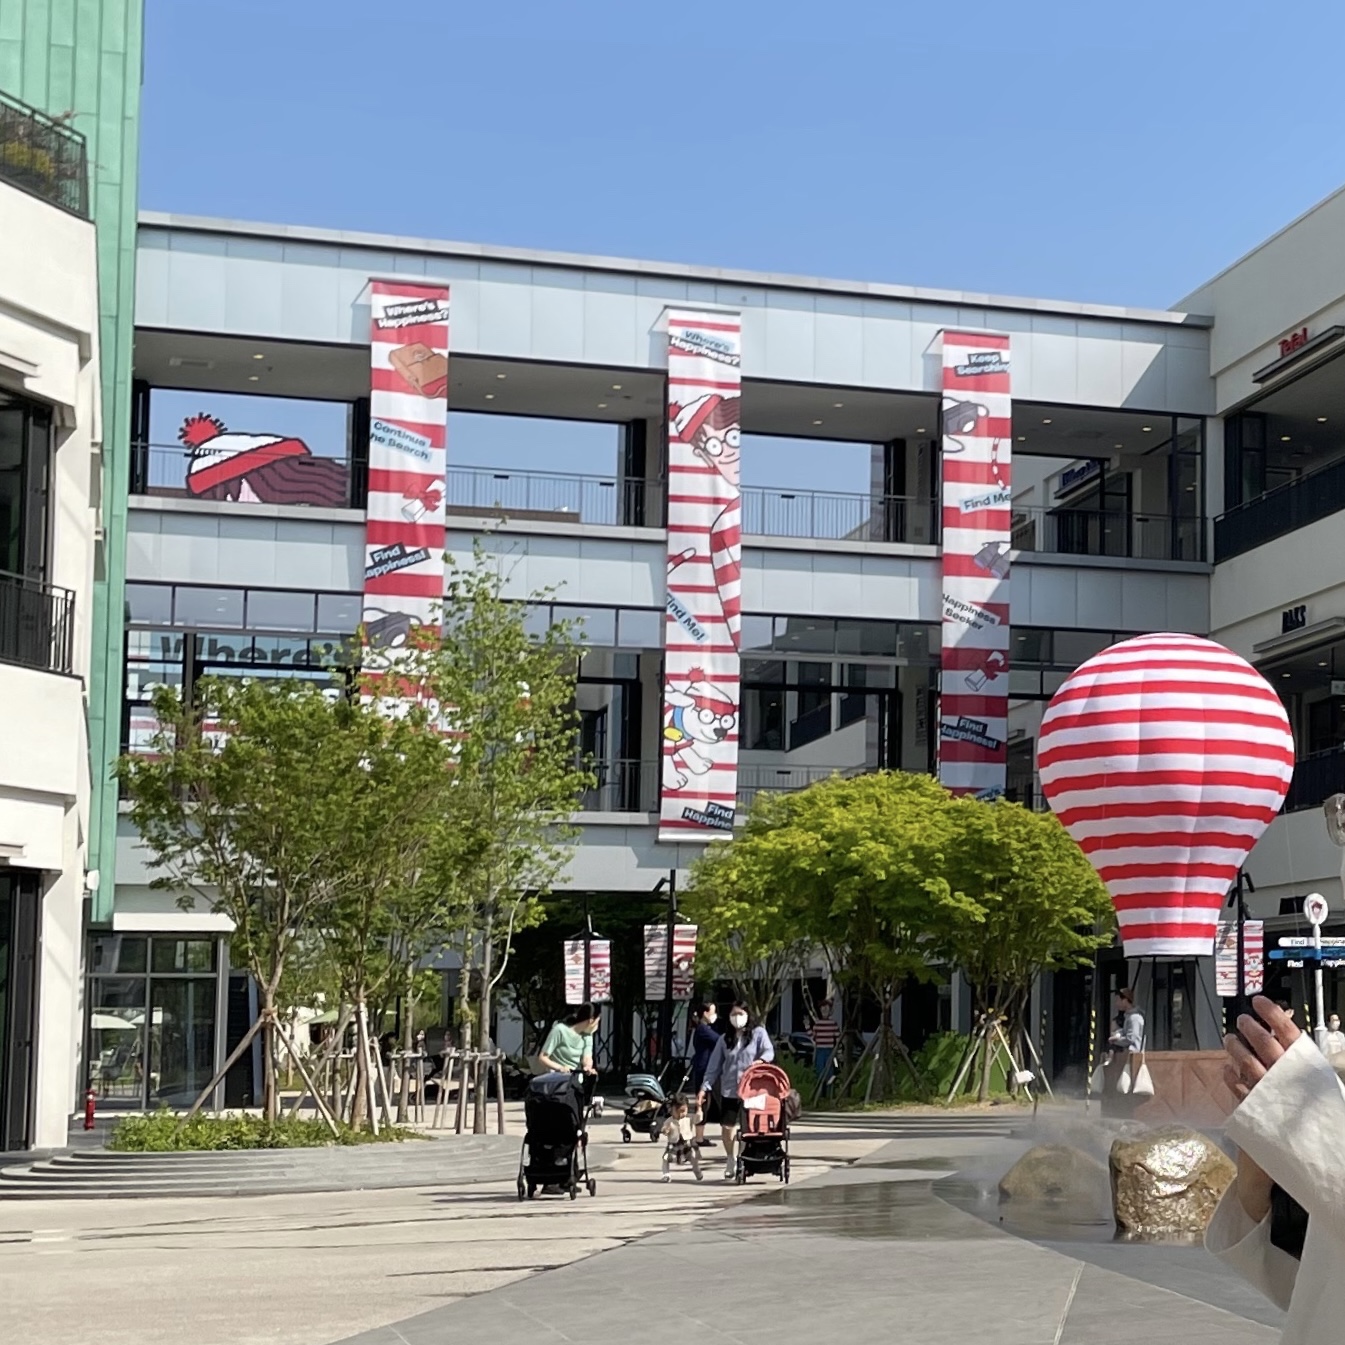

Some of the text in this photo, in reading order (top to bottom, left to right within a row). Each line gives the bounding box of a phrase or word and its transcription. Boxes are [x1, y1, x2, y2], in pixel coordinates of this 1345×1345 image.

[378, 309, 449, 329] Happiness?
[386, 301, 436, 317] Where's
[671, 336, 739, 366] Happiness?
[373, 421, 427, 448] Continue
[963, 496, 991, 511] Find
[372, 545, 401, 562] Find
[365, 550, 426, 579] appiness!
[943, 593, 996, 625] Happiness
[945, 607, 984, 630] Seeker
[682, 617, 706, 641] Me!
[959, 719, 984, 733] Find
[707, 804, 734, 820] Find
